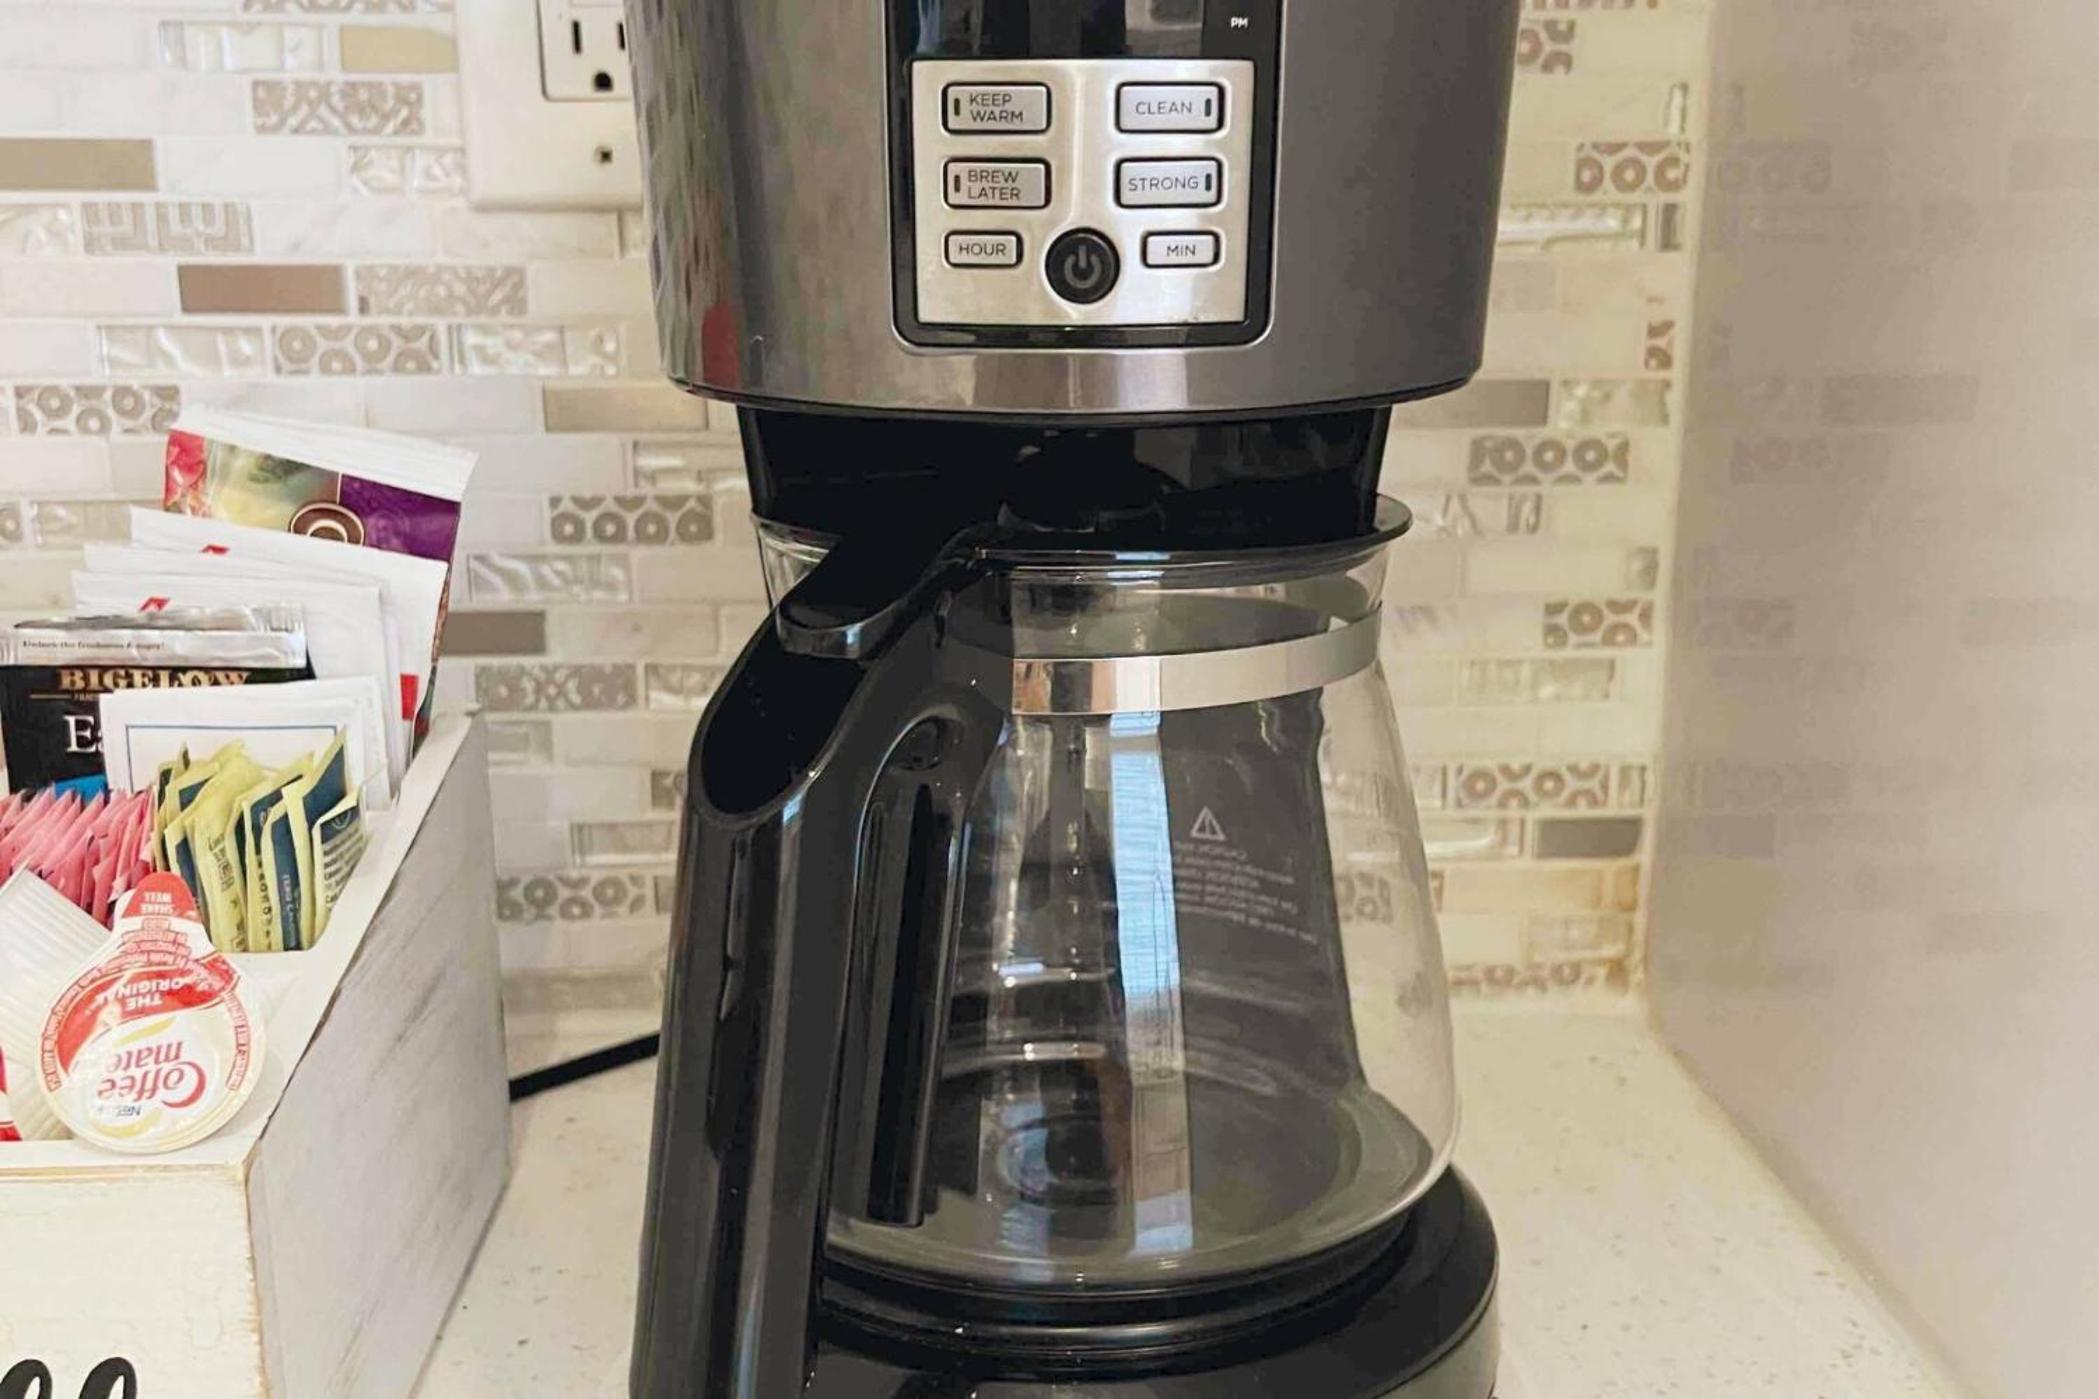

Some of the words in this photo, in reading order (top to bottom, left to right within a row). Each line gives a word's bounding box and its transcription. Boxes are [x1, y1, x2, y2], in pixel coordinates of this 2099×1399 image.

[1230, 16, 1248, 28] PM
[968, 92, 1013, 107] KEEP
[1134, 100, 1193, 116] CLEAN
[969, 109, 1024, 124] WARM
[967, 168, 1020, 184] BREW
[1127, 175, 1200, 192] STRONG
[967, 186, 1021, 201] LATER
[958, 242, 1007, 258] HOUR
[1165, 243, 1197, 258] MIN
[59, 668, 250, 691] BIGELOW
[63, 713, 103, 753] E
[126, 993, 163, 1011] THE
[106, 1040, 184, 1073] mate
[96, 1060, 207, 1109] Coffee
